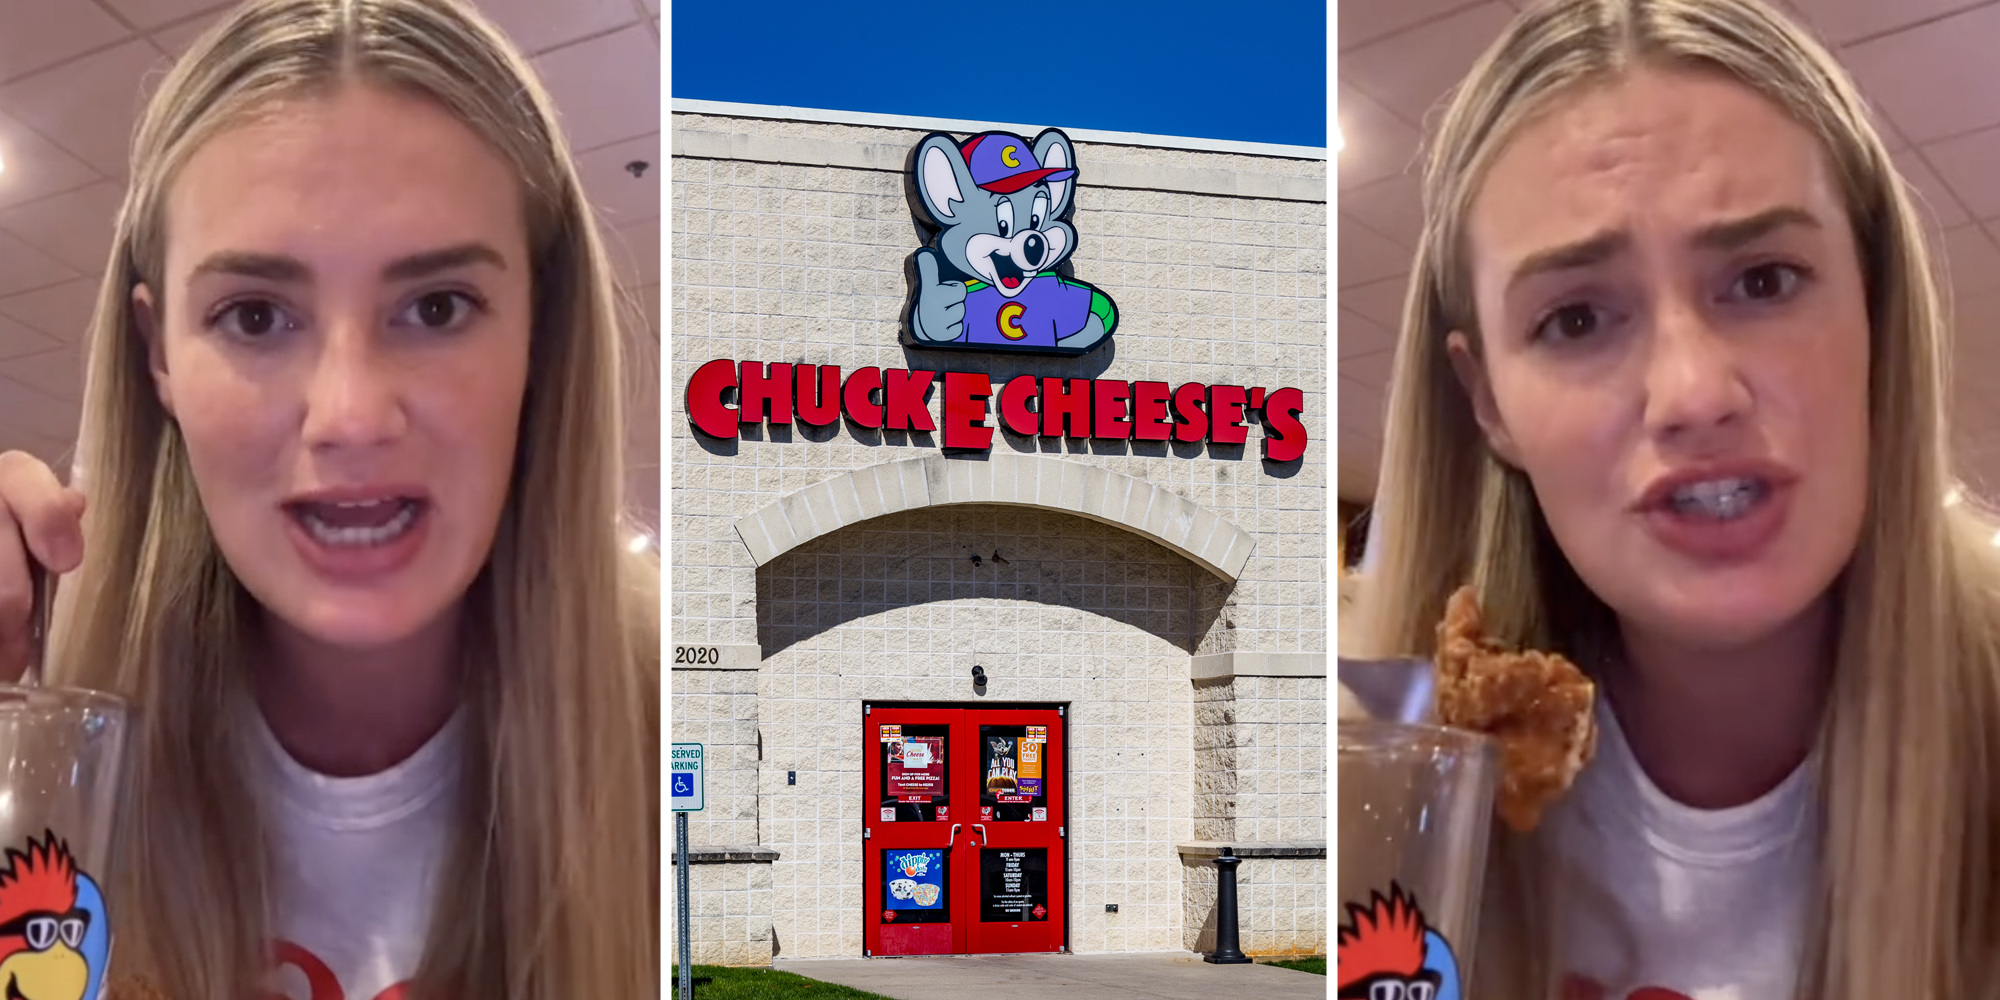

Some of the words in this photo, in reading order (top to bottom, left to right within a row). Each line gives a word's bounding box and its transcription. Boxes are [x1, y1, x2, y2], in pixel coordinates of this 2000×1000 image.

[1001, 145, 1020, 168] C
[996, 301, 1028, 341] C
[686, 358, 937, 440] CHUCK
[943, 371, 995, 450] E
[998, 374, 1308, 462] CHEESE'S
[675, 646, 719, 665] 2020
[1022, 743, 1037, 752] 50
[991, 758, 1000, 768] ALL
[1002, 757, 1014, 769] YOU
[988, 768, 1000, 780] CAN
[1002, 767, 1017, 780] PLAY
